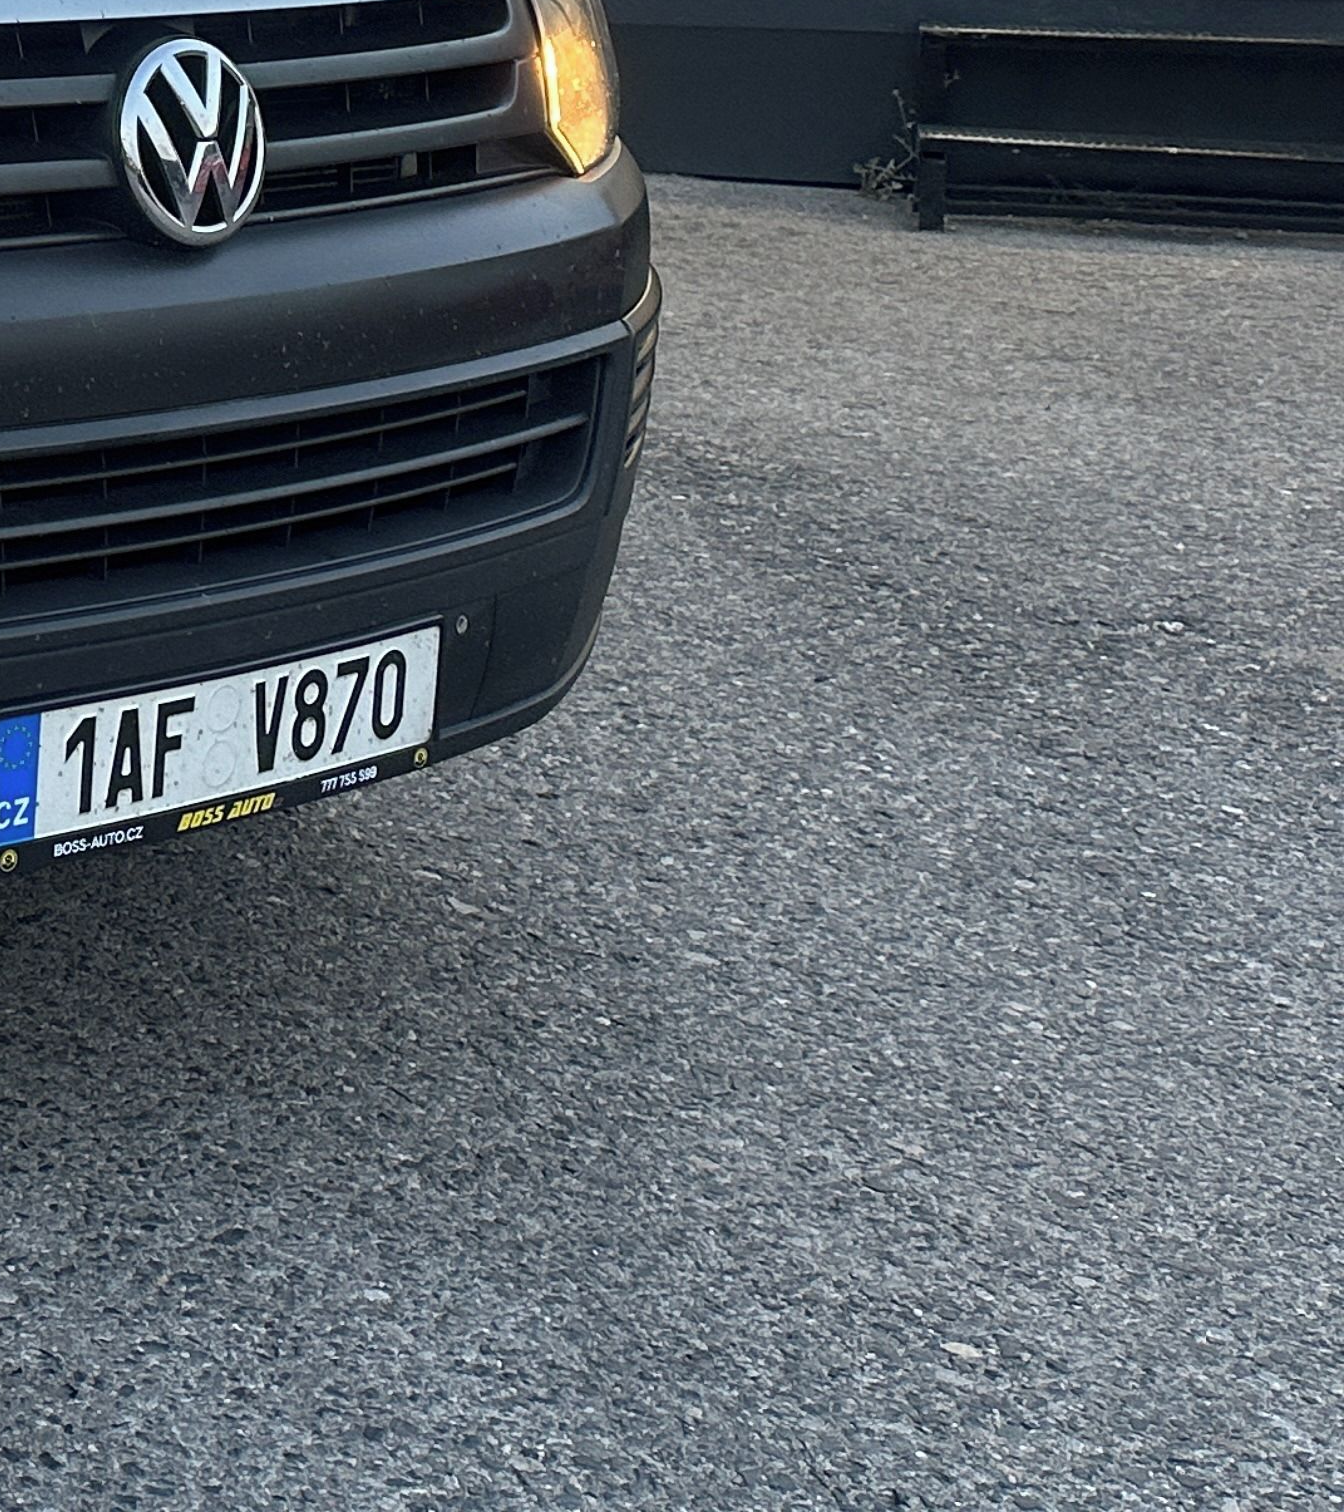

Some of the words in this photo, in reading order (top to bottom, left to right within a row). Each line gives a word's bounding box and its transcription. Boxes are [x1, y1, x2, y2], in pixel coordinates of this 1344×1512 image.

[64, 695, 196, 815] 1AF
[255, 648, 408, 774] V870
[320, 776, 338, 793] 777
[339, 772, 357, 787] 755
[358, 765, 378, 782] 599
[177, 805, 225, 833] BOSS
[226, 792, 276, 821] AUTO
[53, 825, 145, 858] BOSS-AUTO.CZ
